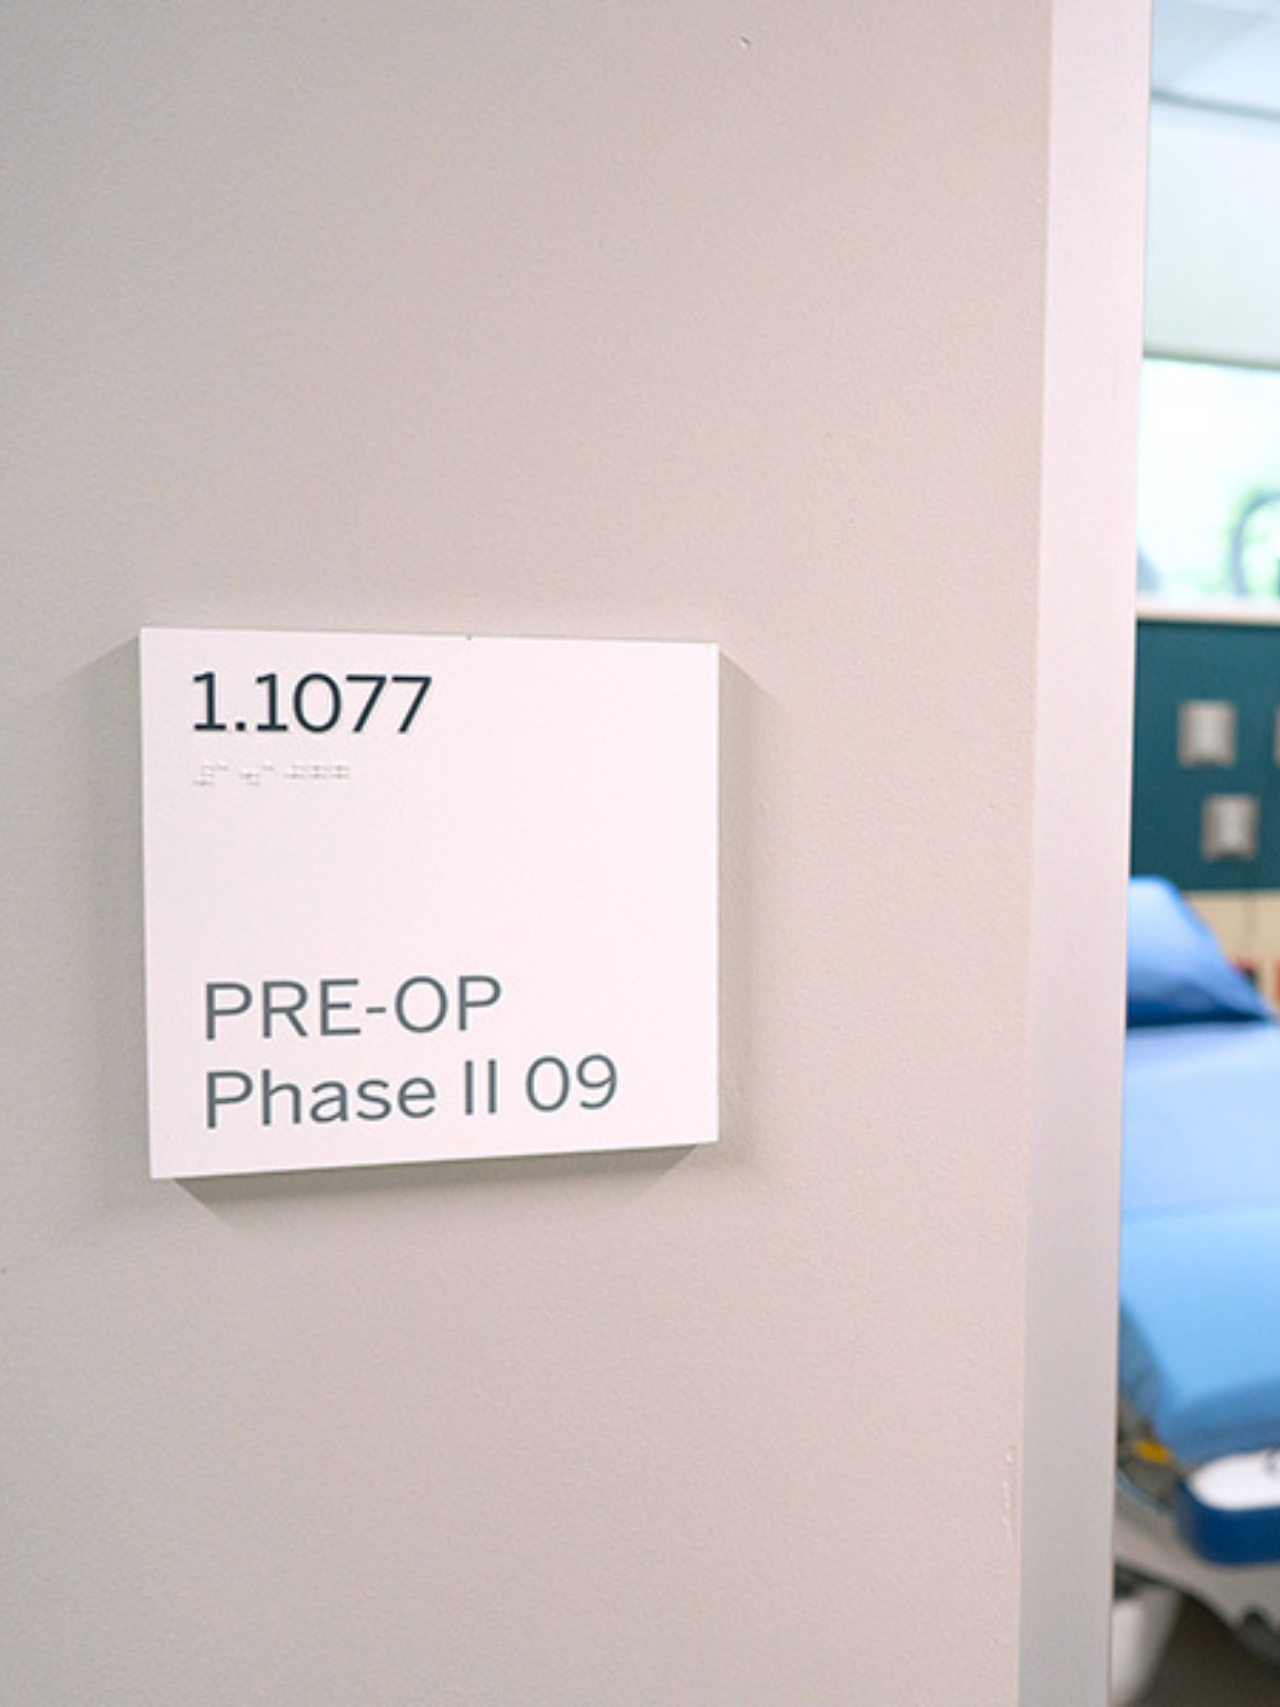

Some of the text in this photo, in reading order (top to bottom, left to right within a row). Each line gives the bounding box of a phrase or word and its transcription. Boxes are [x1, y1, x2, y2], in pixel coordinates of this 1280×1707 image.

[192, 671, 433, 734] 1.1077
[205, 975, 502, 1040] PRE-OP
[205, 1053, 618, 1130] Phase II 09
